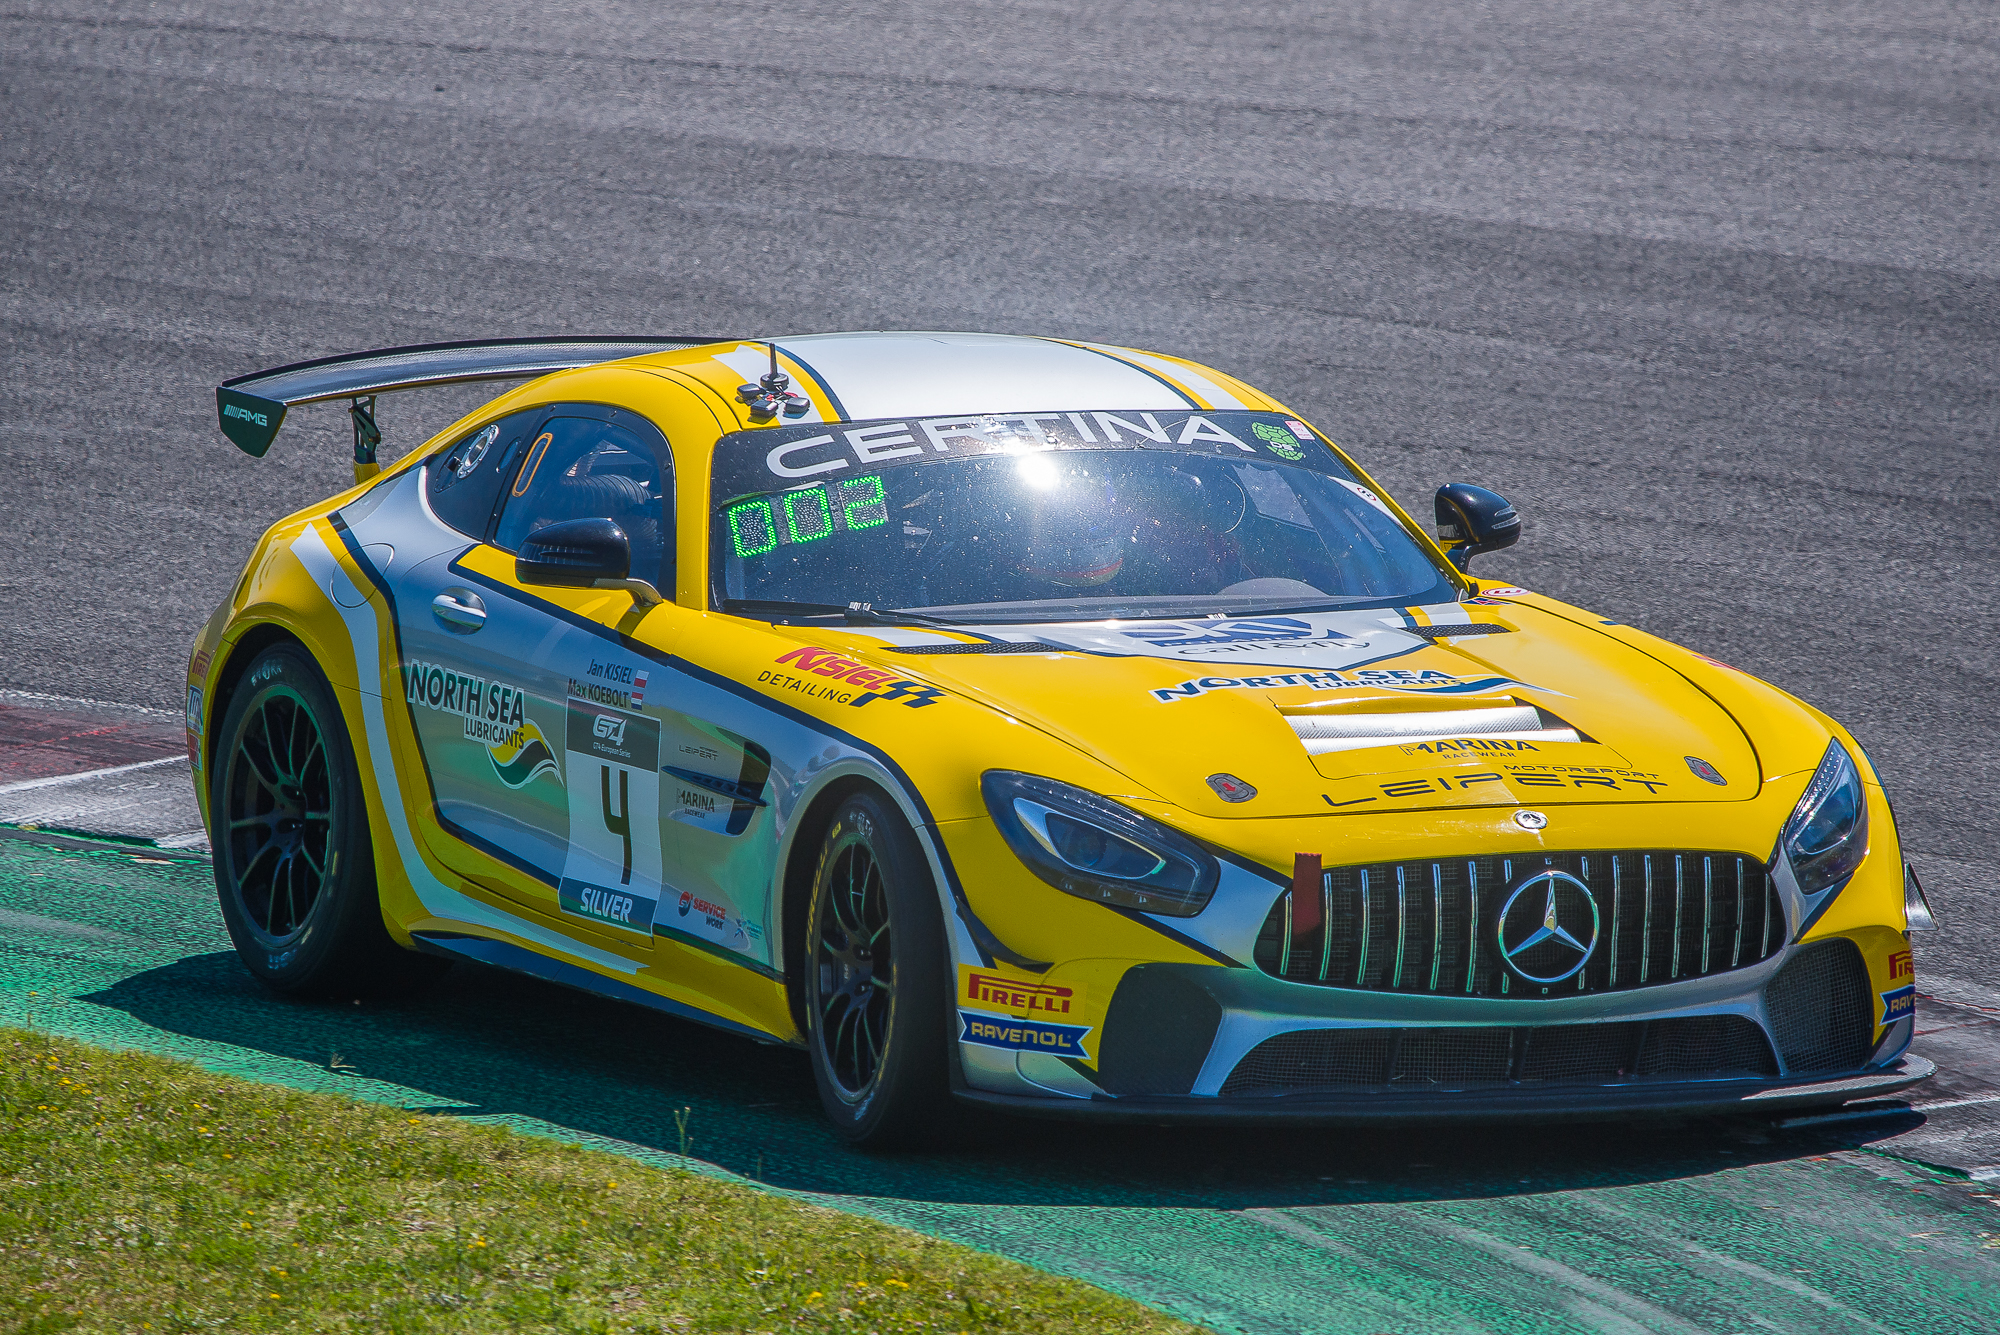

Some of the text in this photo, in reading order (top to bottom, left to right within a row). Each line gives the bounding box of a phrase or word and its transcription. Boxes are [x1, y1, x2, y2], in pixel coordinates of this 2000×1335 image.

[236, 407, 268, 427] AMG
[766, 411, 1257, 479] CERTINA
[728, 474, 888, 558] 002
[586, 658, 633, 685] Jan KISIEL
[1152, 669, 1459, 701] NORTH SEA
[1312, 677, 1462, 690] LUBRICANTS
[407, 660, 525, 729] NORTH SEA
[567, 677, 629, 708] Max KOEBOLT
[757, 670, 852, 704] DETAILING
[464, 716, 525, 750] LUBRICANTS
[592, 713, 627, 746] GT4
[678, 744, 719, 761] LEIPERT
[1399, 739, 1541, 757] MARINA
[1442, 750, 1517, 760] RACEWEAR
[1503, 764, 1660, 781] MOTORSPORT
[676, 788, 715, 813] MARINA
[1321, 772, 1669, 807] LEIPERT
[601, 764, 633, 886] 4
[684, 807, 706, 820] RACEWEAR
[580, 887, 633, 924] SILVER
[693, 897, 726, 921] SERVICE
[705, 915, 724, 931] WORK
[1888, 950, 1915, 980] PIR
[967, 972, 1074, 1014] PIRELLI
[970, 1021, 1072, 1048] RAVENOL
